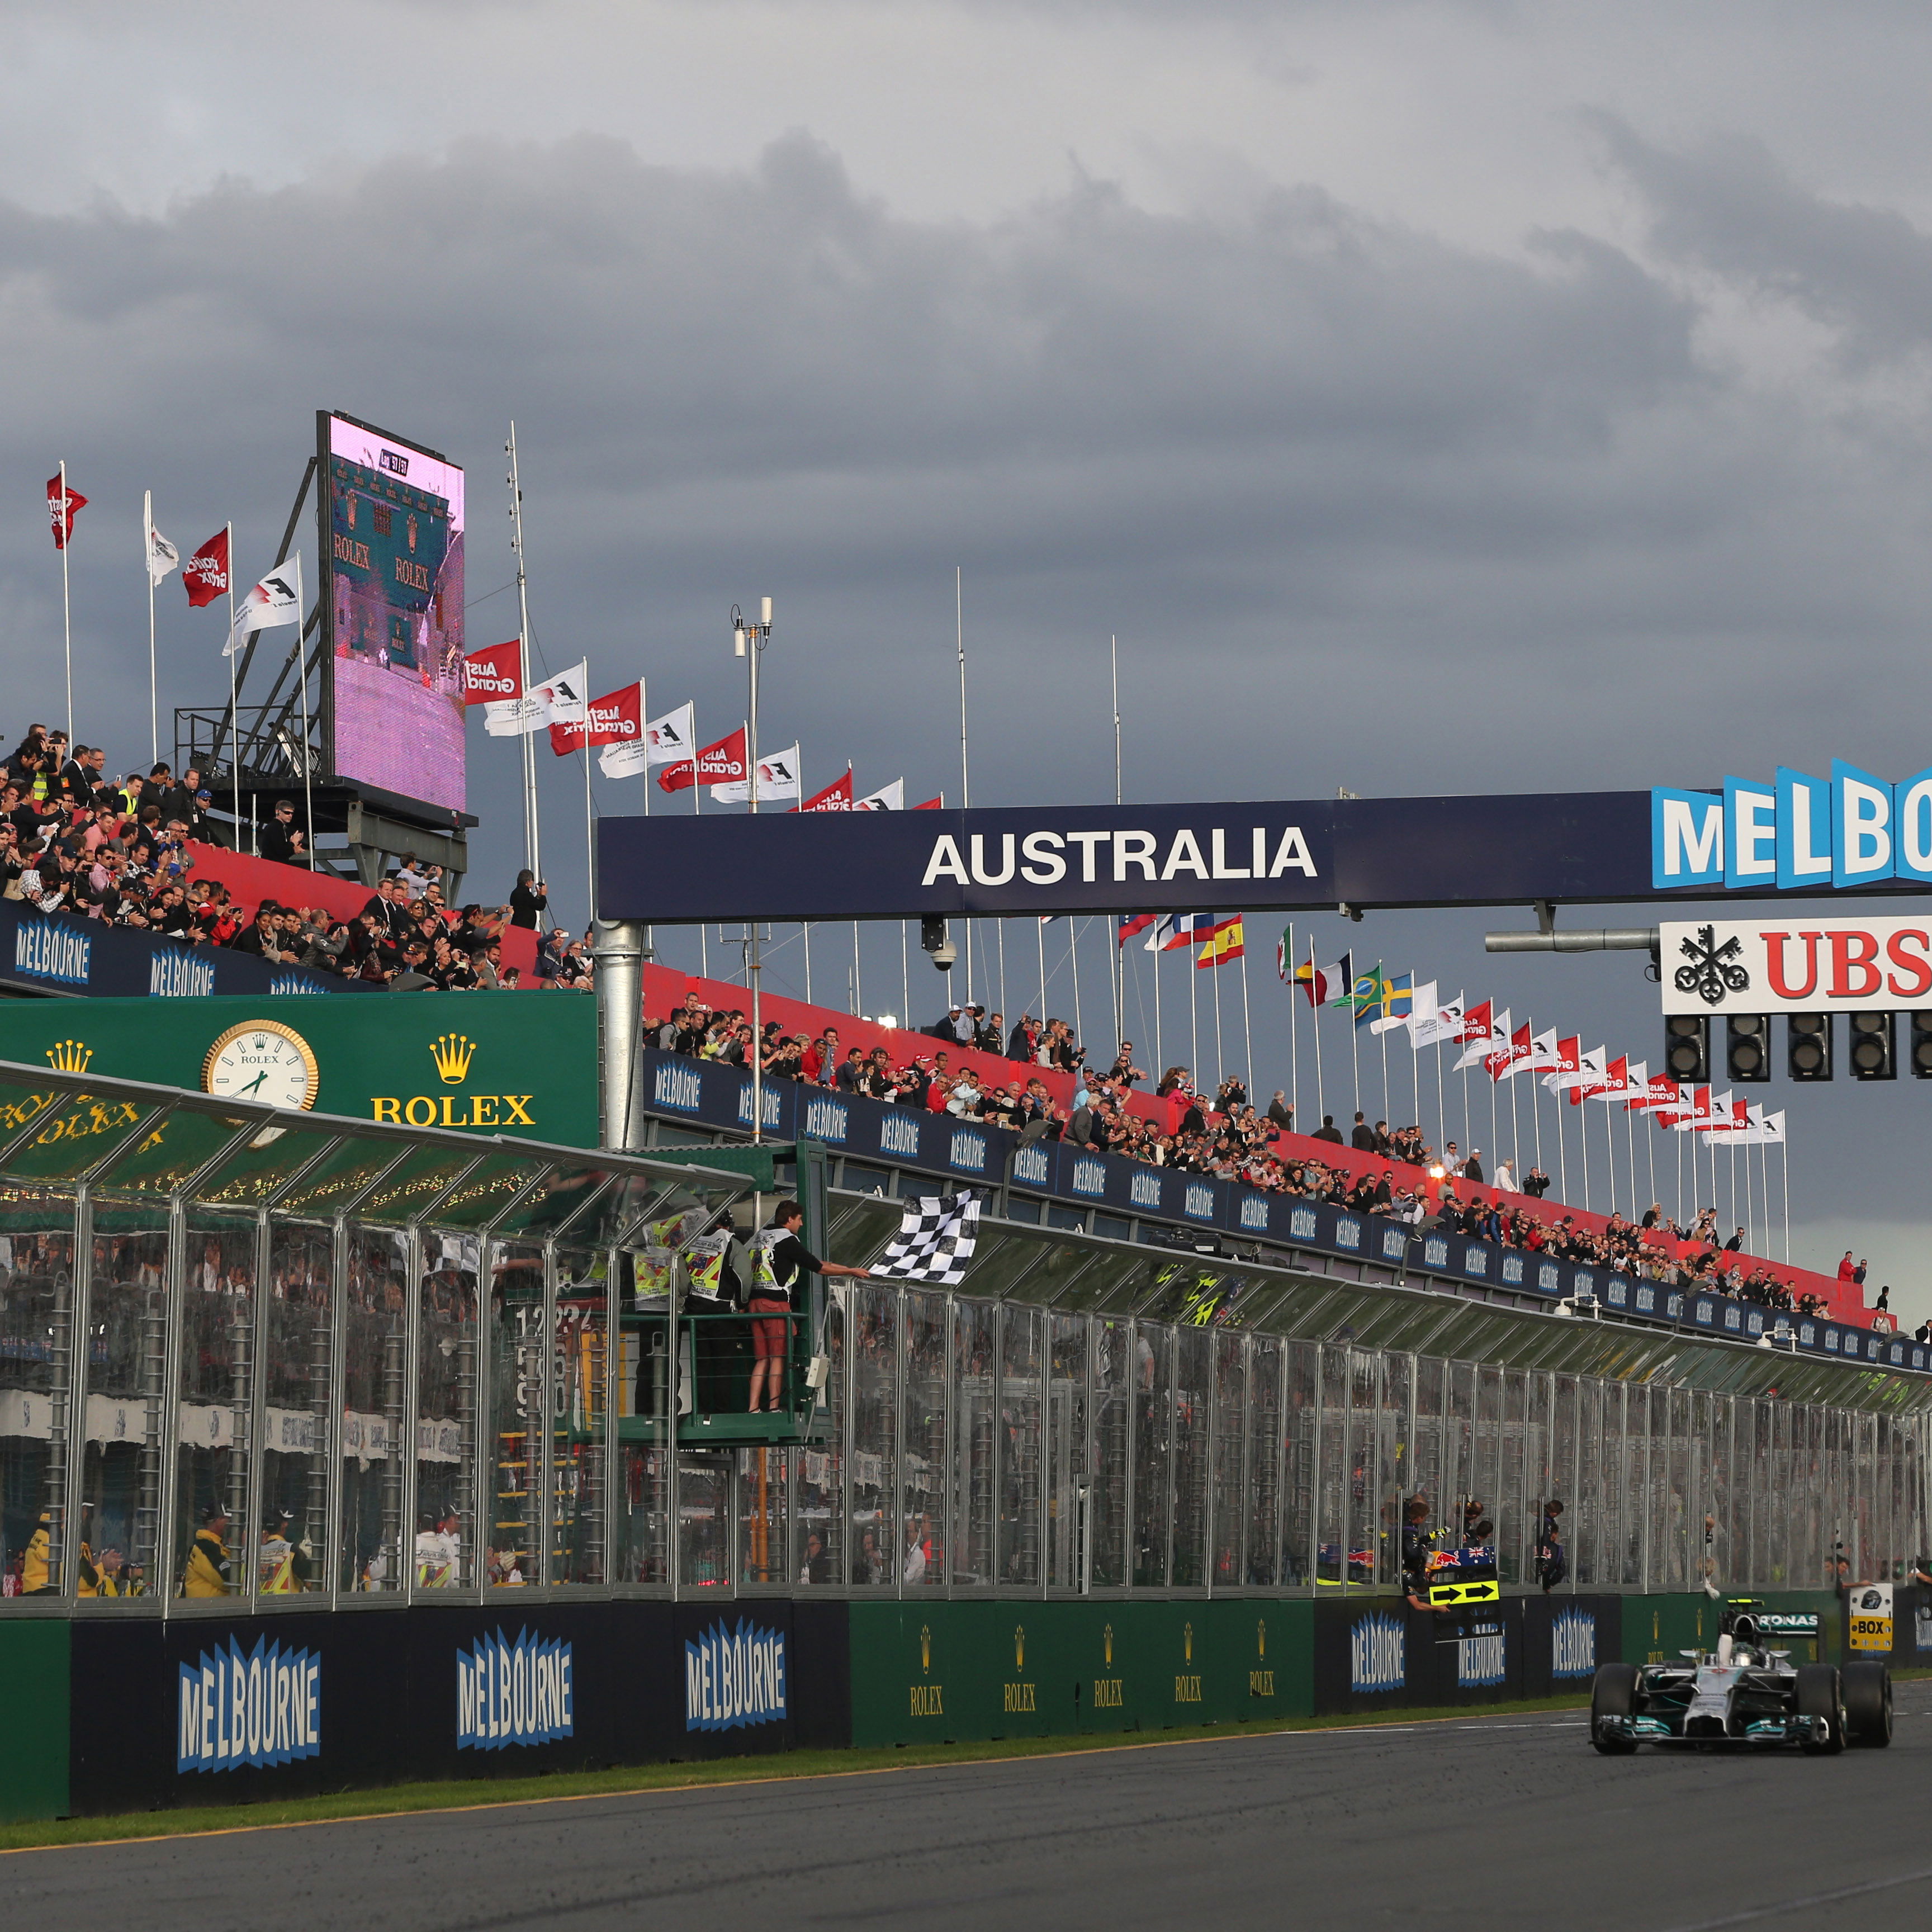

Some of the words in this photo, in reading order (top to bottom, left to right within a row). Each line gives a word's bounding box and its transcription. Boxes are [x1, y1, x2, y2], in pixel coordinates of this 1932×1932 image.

[334, 533, 370, 570] ROLEX
[395, 556, 429, 592] ROLEX
[921, 827, 1318, 886] AUSTRALIA
[16, 926, 89, 979] MELBOURNE
[1759, 929, 1932, 999] UBS
[150, 954, 214, 997] MELBOURNE
[241, 1055, 280, 1064] ROLEX
[655, 1067, 700, 1107] MELBOURNE
[371, 1095, 536, 1127] ROLEX
[807, 1101, 847, 1139] MELBOURNE
[880, 1117, 919, 1154] MELBOURNE
[951, 1133, 986, 1168] MELBOURNE
[1014, 1148, 1048, 1182] MELBOURNE
[1073, 1161, 1106, 1193] MELBOURNE
[1130, 1173, 1161, 1205] MELBOURNE
[1185, 1186, 1214, 1217] MELBOURNE
[1554, 1617, 1594, 1671] MELBOURNE
[1858, 1621, 1884, 1635] BOX
[1352, 1623, 1404, 1684] MELBOURNE
[459, 1644, 571, 1739] MELBOURNE
[688, 1634, 784, 1720] MELBOURNE
[1095, 1679, 1123, 1707] ROLEX
[1175, 1675, 1201, 1702] ROLEX
[1249, 1671, 1274, 1696] ROLEX
[181, 1655, 318, 1759] MELBOURNE
[910, 1685, 943, 1716] ROLEX
[1004, 1683, 1035, 1712] ROLEX
